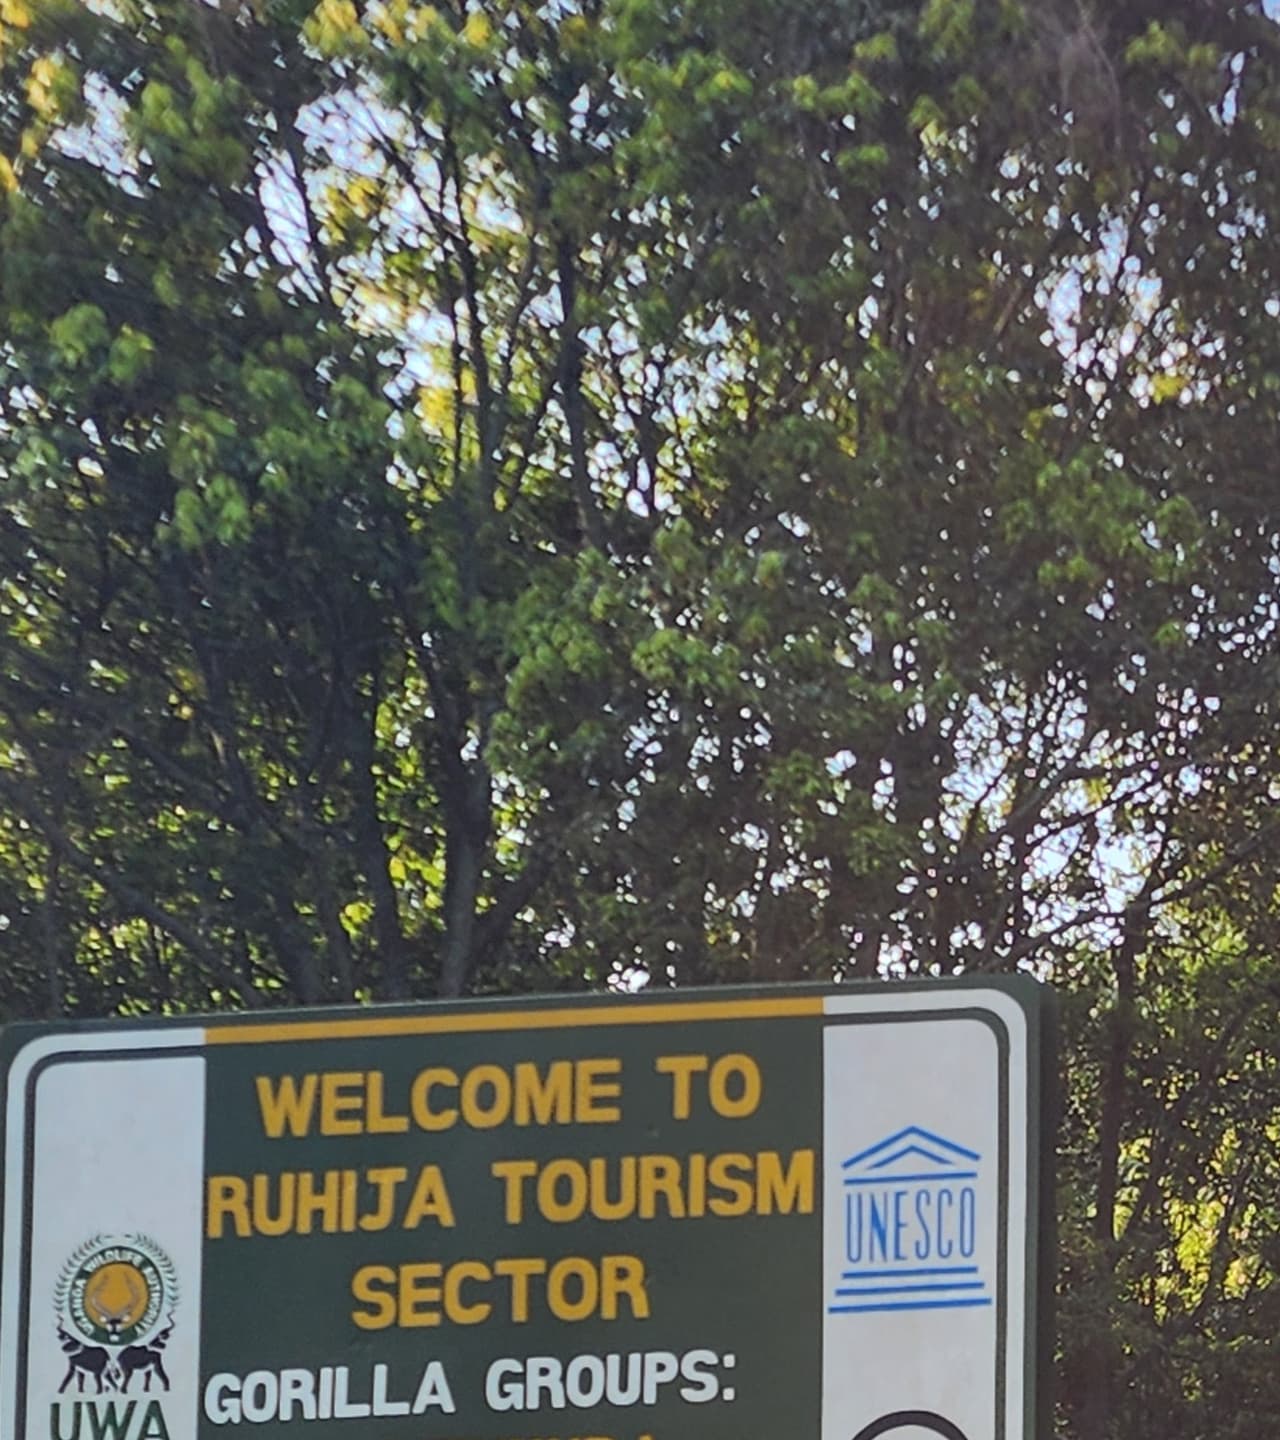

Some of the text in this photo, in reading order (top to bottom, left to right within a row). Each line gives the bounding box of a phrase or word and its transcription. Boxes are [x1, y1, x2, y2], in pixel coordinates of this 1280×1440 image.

[256, 1053, 762, 1138] WELCOME TO
[206, 1149, 815, 1239] RUHIJA TOURISM
[846, 1187, 975, 1264] UNESCO
[351, 1255, 650, 1330] SECTOR
[204, 1349, 736, 1425] GORILLA GROUPS:
